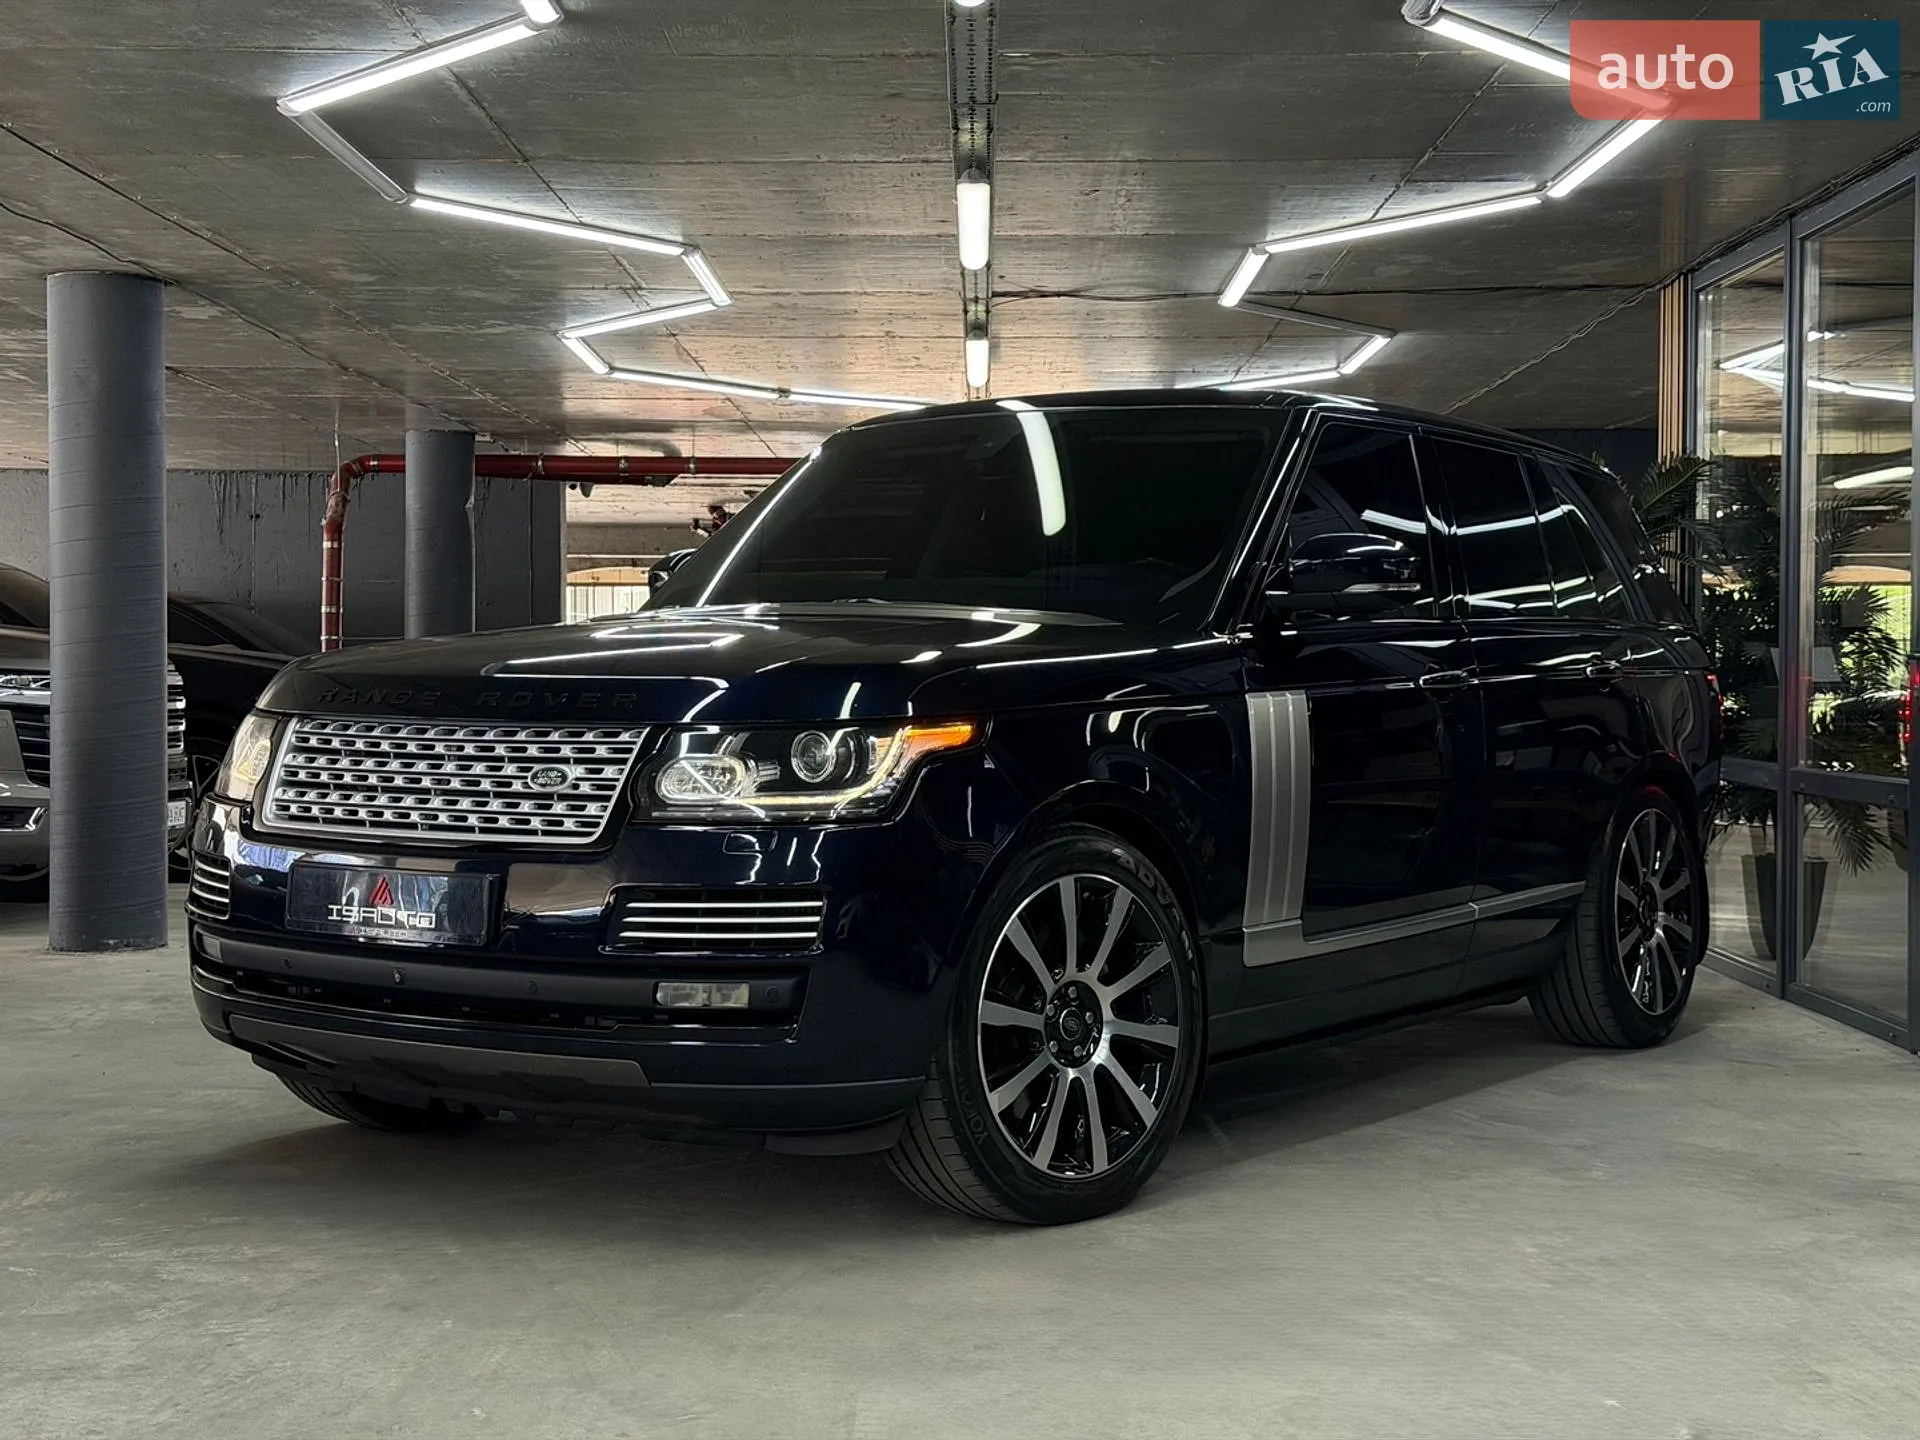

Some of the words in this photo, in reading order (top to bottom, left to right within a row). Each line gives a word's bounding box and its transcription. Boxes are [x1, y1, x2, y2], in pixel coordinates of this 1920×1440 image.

[318, 687, 442, 707] RANGE
[473, 689, 642, 714] ROVER
[537, 770, 558, 778] LAND
[537, 777, 562, 785] ROVER
[327, 904, 436, 928] ISAUTO
